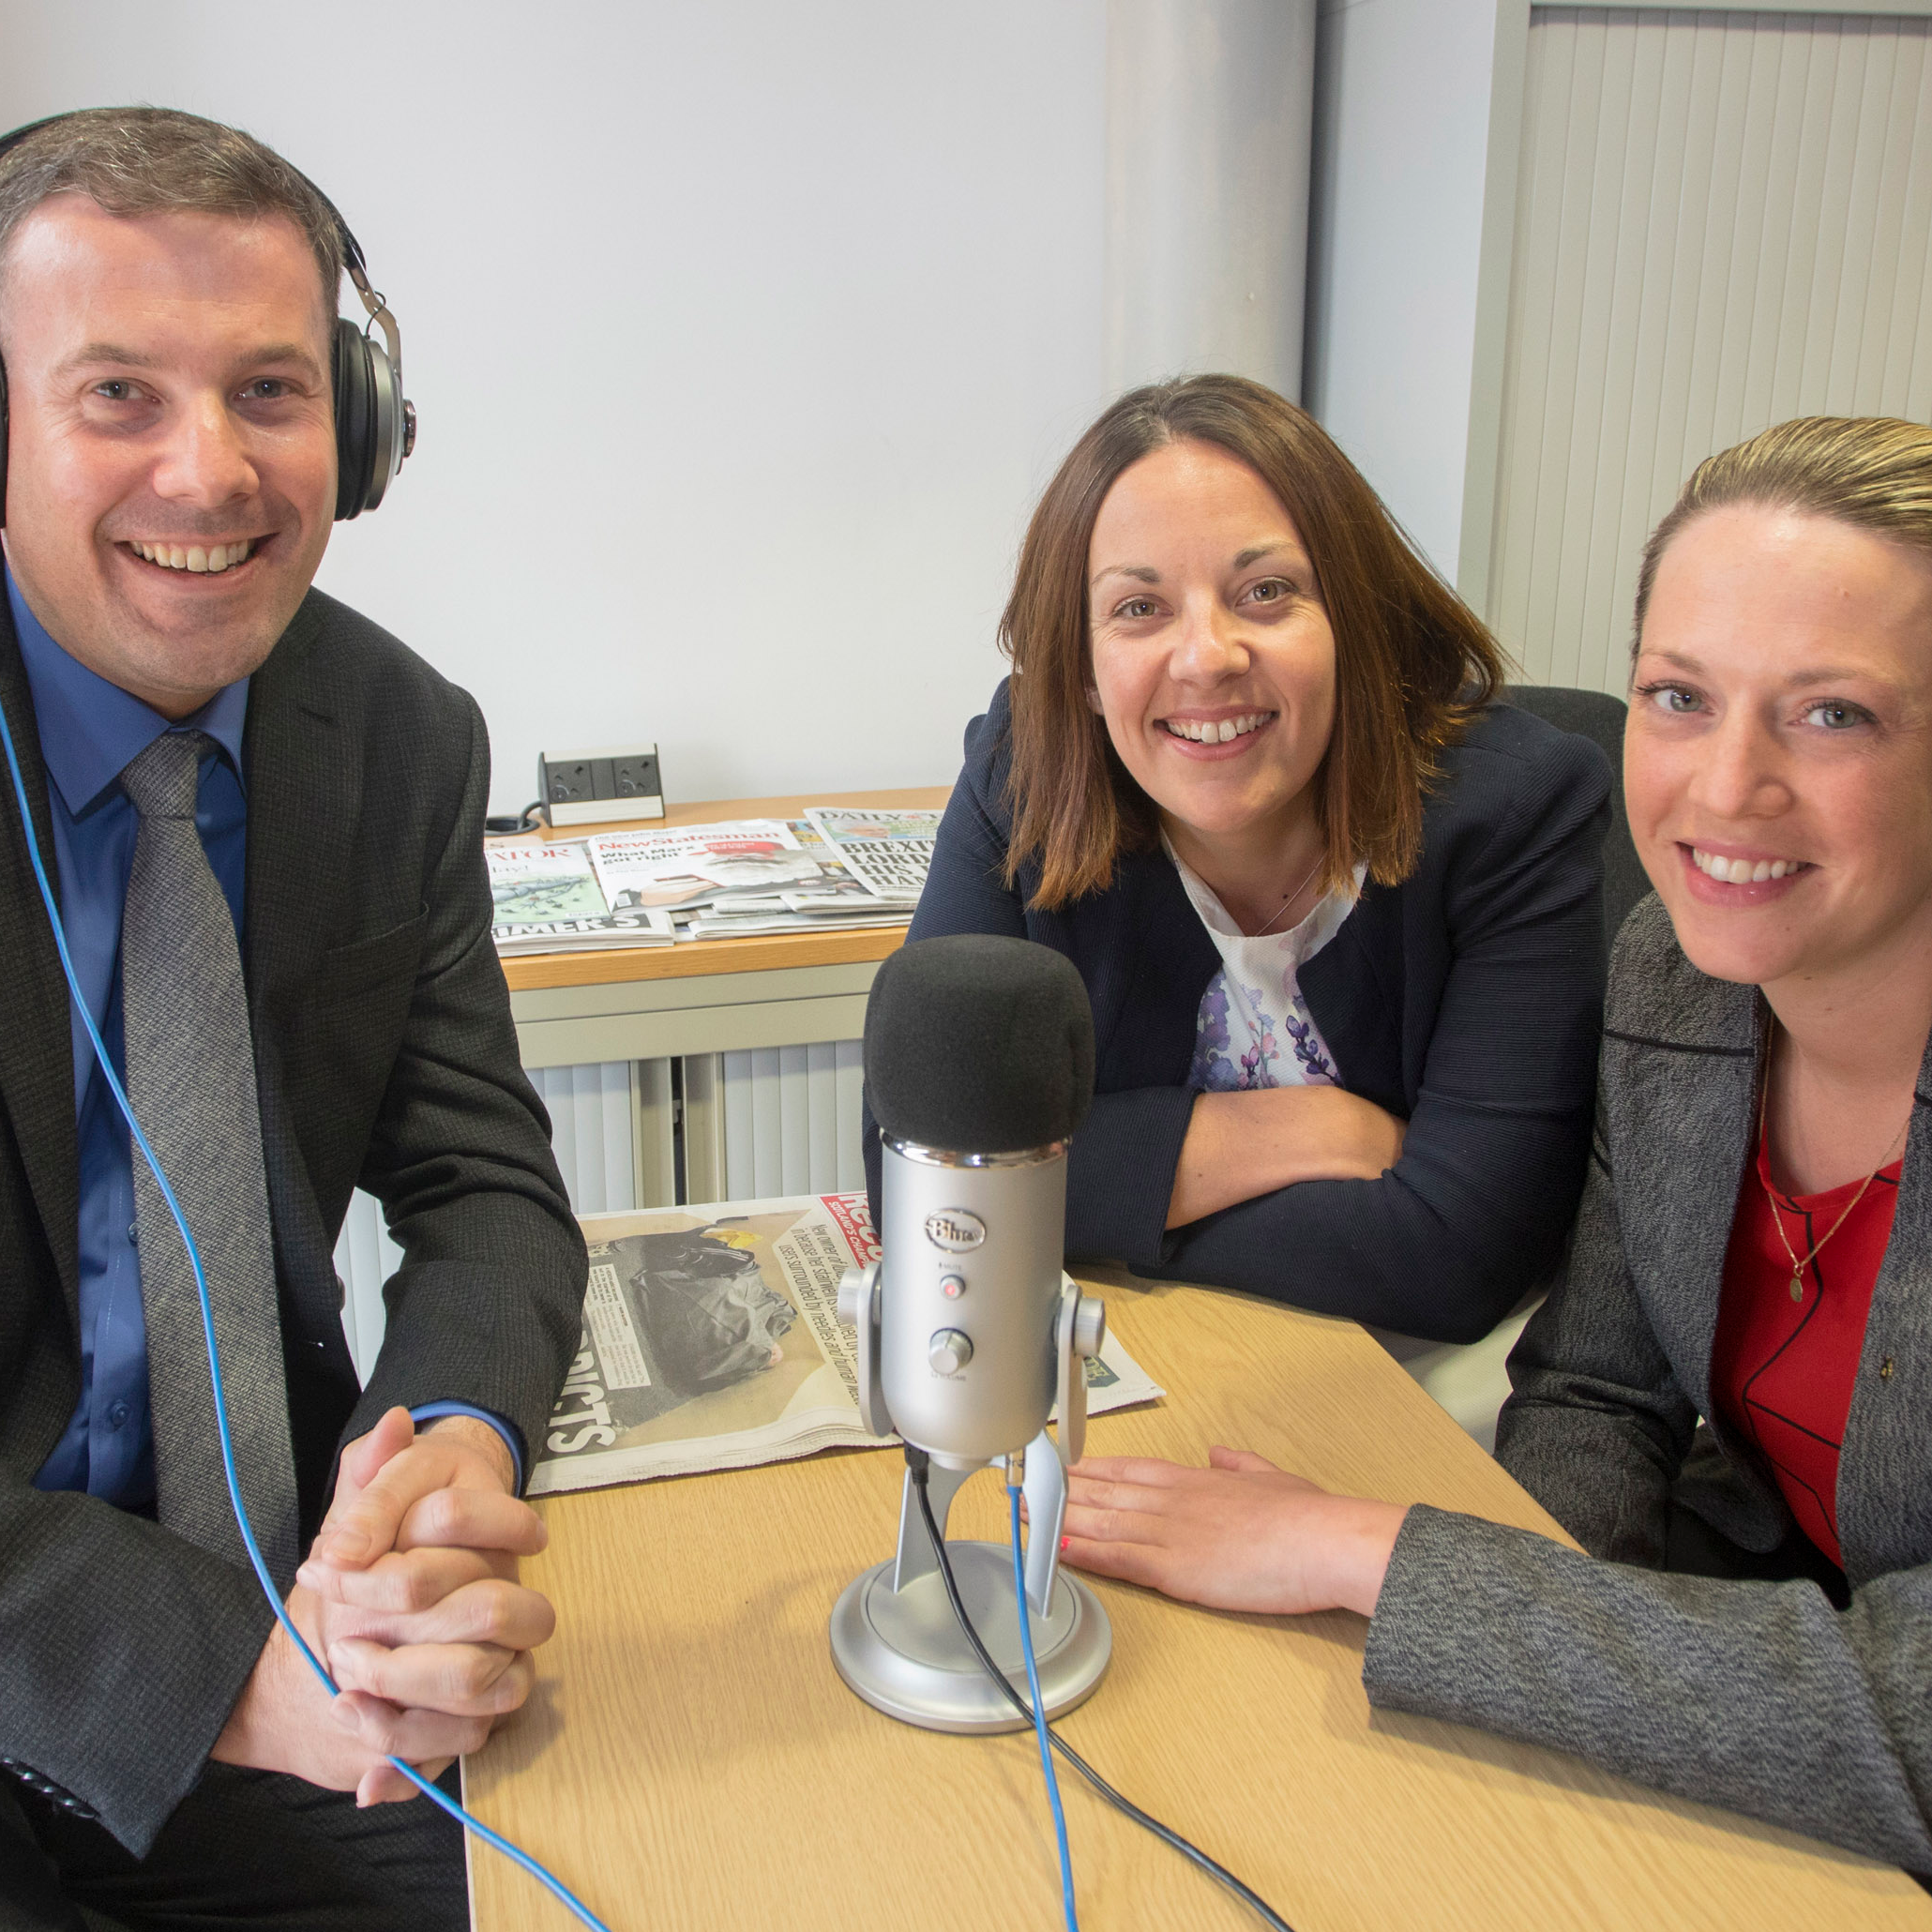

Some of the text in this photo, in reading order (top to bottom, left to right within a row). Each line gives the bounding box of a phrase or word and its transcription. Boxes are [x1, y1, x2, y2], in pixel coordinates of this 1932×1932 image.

[816, 810, 901, 821] DAILY
[489, 847, 572, 862] ATOR
[600, 849, 645, 859] What
[651, 845, 695, 855] Marx
[602, 852, 680, 866] got right
[850, 853, 931, 865] LORD
[859, 865, 913, 876] HIS
[828, 1201, 858, 1235] SCOTLAND'S
[809, 1224, 828, 1236] New
[928, 1218, 977, 1242] Blue
[794, 1232, 821, 1257] because
[817, 1237, 839, 1257] owner
[778, 1245, 799, 1261] users
[827, 1256, 849, 1265] of
[806, 1257, 826, 1268] her
[787, 1260, 823, 1301] surrounded
[812, 1268, 838, 1297] stairwell
[802, 1301, 824, 1312] by
[809, 1312, 838, 1341] needles
[823, 1342, 850, 1357] and
[831, 1357, 858, 1384] human
